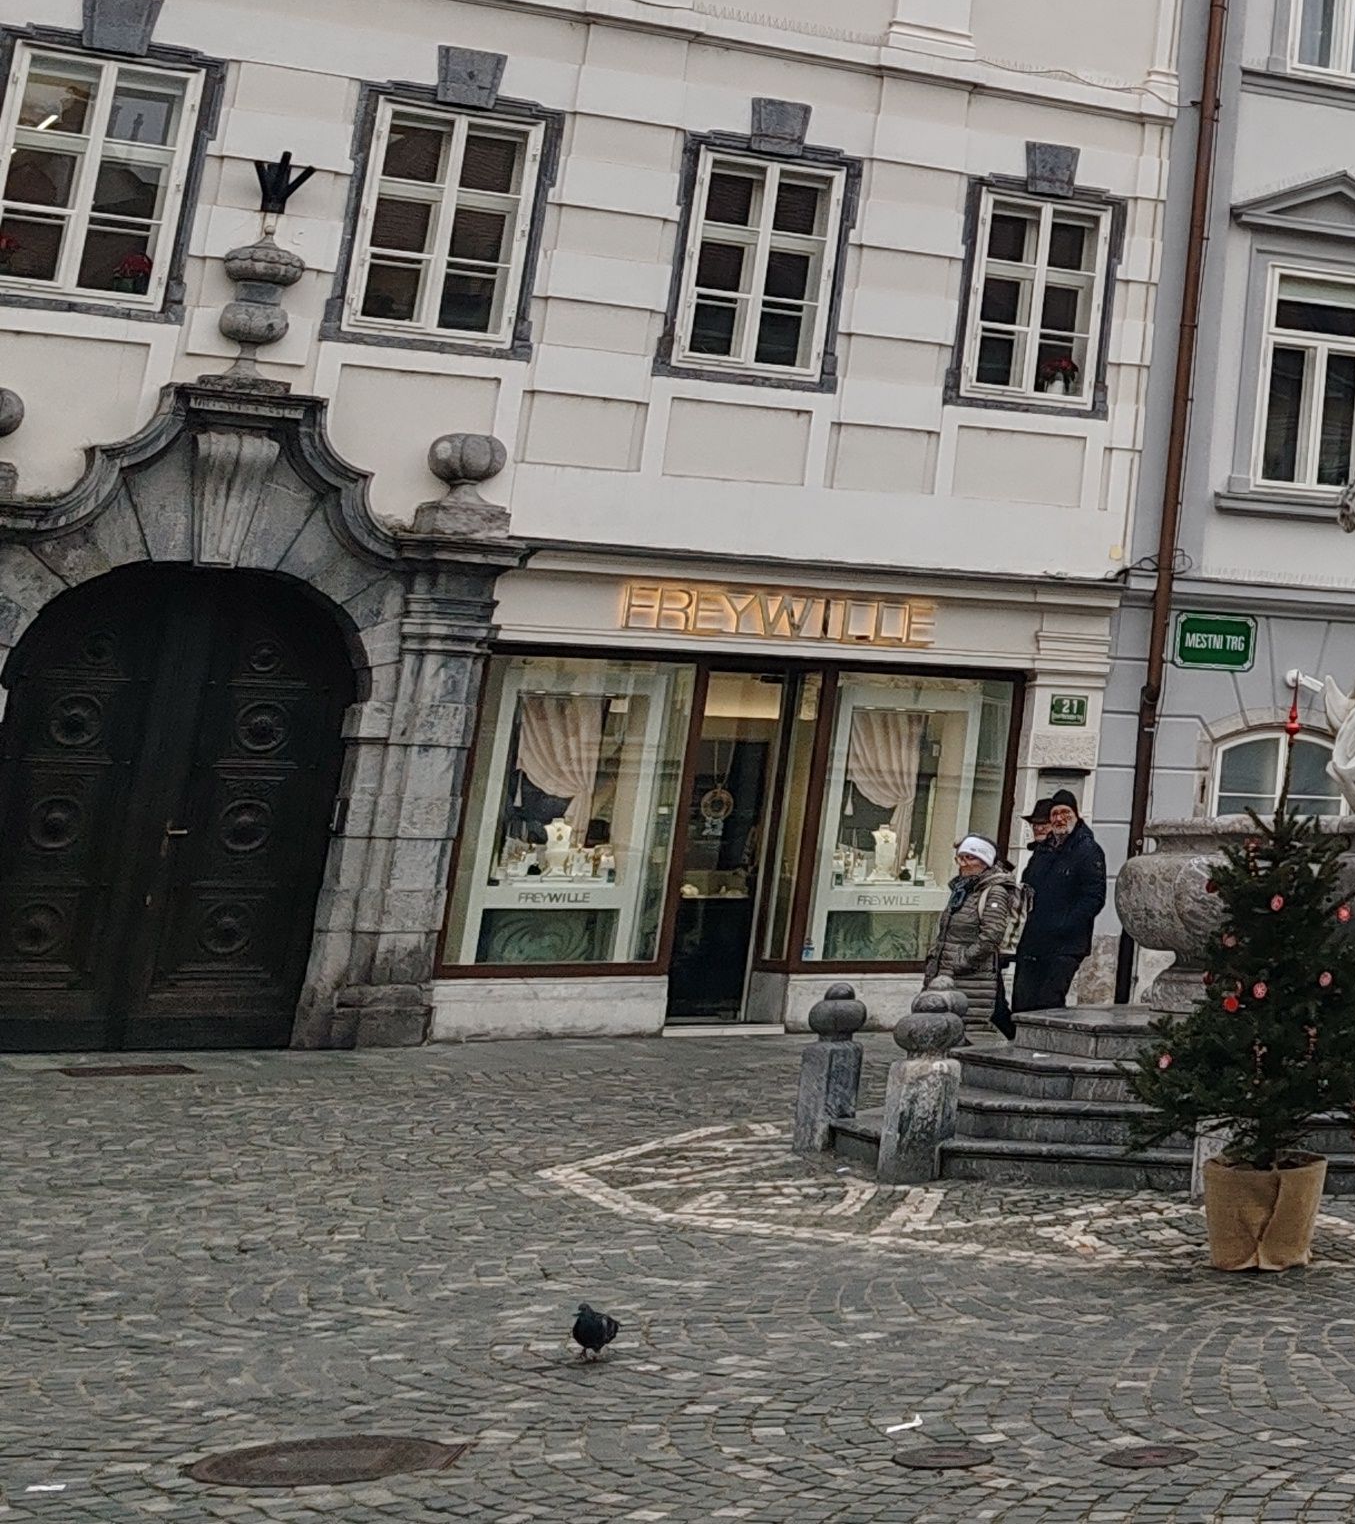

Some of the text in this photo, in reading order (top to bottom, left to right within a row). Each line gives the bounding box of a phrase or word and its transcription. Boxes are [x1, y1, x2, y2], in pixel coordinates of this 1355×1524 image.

[622, 584, 936, 646] FREYWILLE
[1185, 632, 1245, 651] MESTNI TRG
[1062, 699, 1078, 714] 21
[517, 892, 591, 903] FREYWILLE
